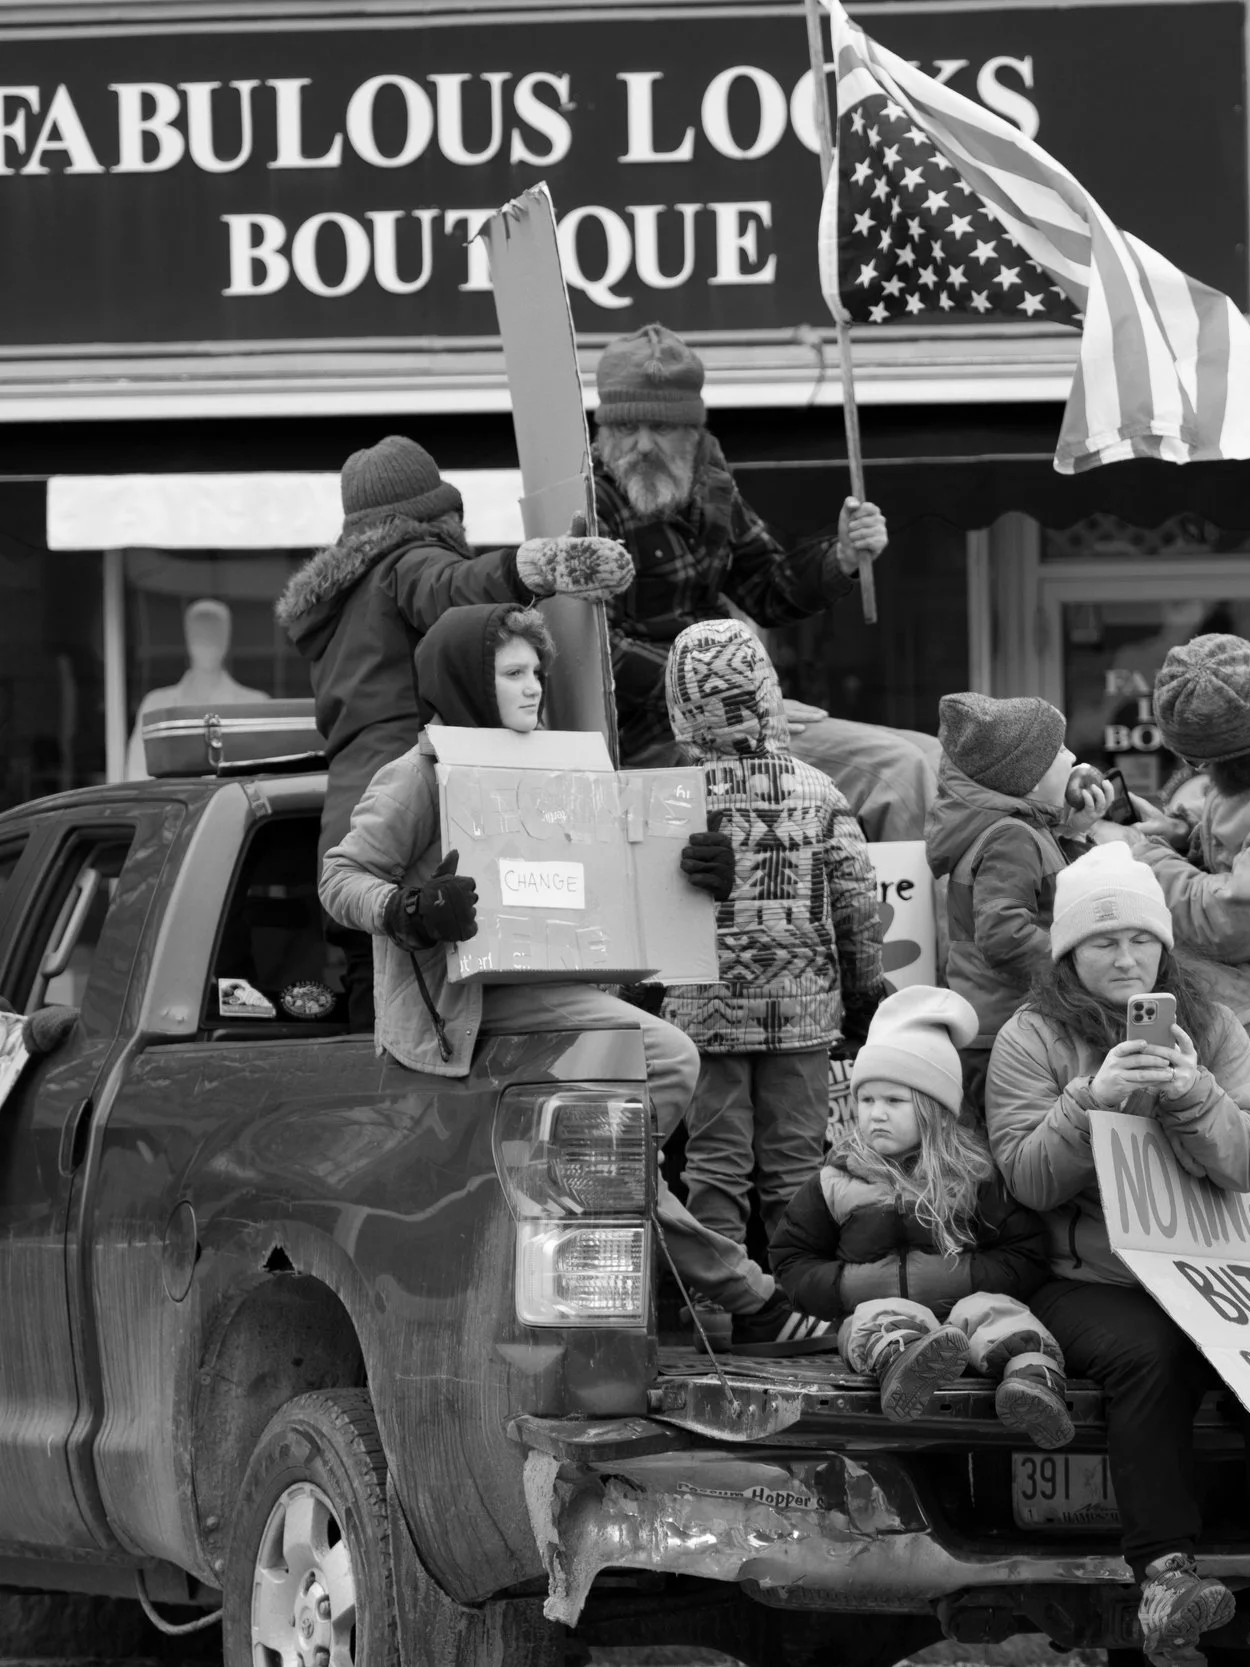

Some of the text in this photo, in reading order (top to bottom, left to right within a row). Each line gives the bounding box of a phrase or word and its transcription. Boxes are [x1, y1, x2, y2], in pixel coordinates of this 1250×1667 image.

[0, 71, 573, 176] FABULOUS
[219, 200, 778, 310] BOUTQUE
[504, 869, 579, 893] CHANGE
[1111, 1127, 1178, 1240] NO
[752, 1487, 811, 1508] Hopper
[1021, 1456, 1070, 1501] 391
